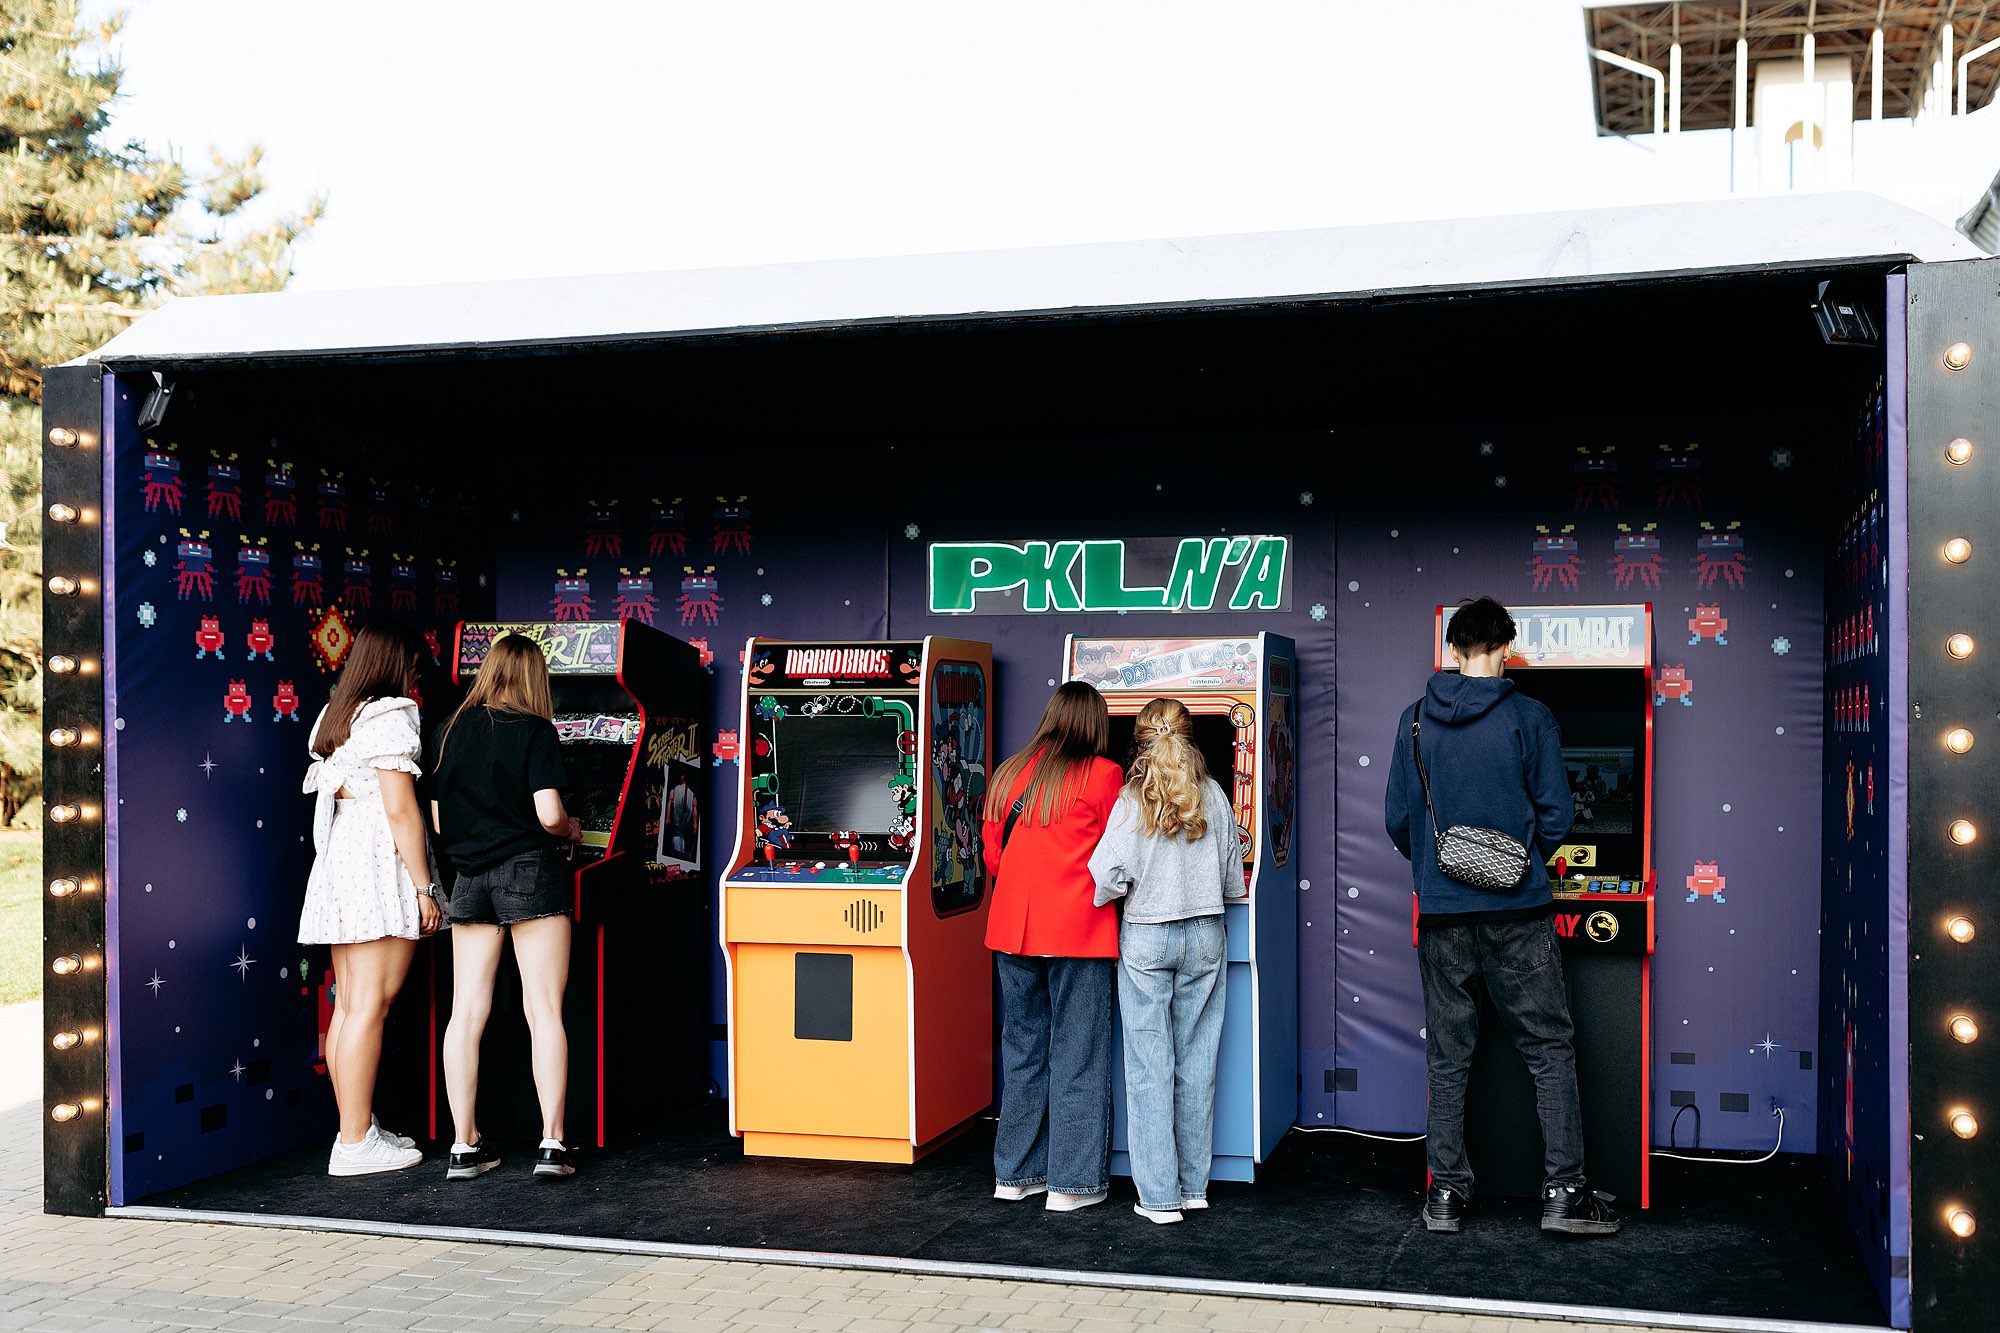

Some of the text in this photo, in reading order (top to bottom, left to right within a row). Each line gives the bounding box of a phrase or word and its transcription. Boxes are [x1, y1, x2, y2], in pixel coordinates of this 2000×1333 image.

[1540, 616, 1634, 657] KOMBAT
[784, 649, 843, 678] MARIO
[1120, 642, 1235, 687] DONKEY KONG
[646, 726, 674, 767] STREET
